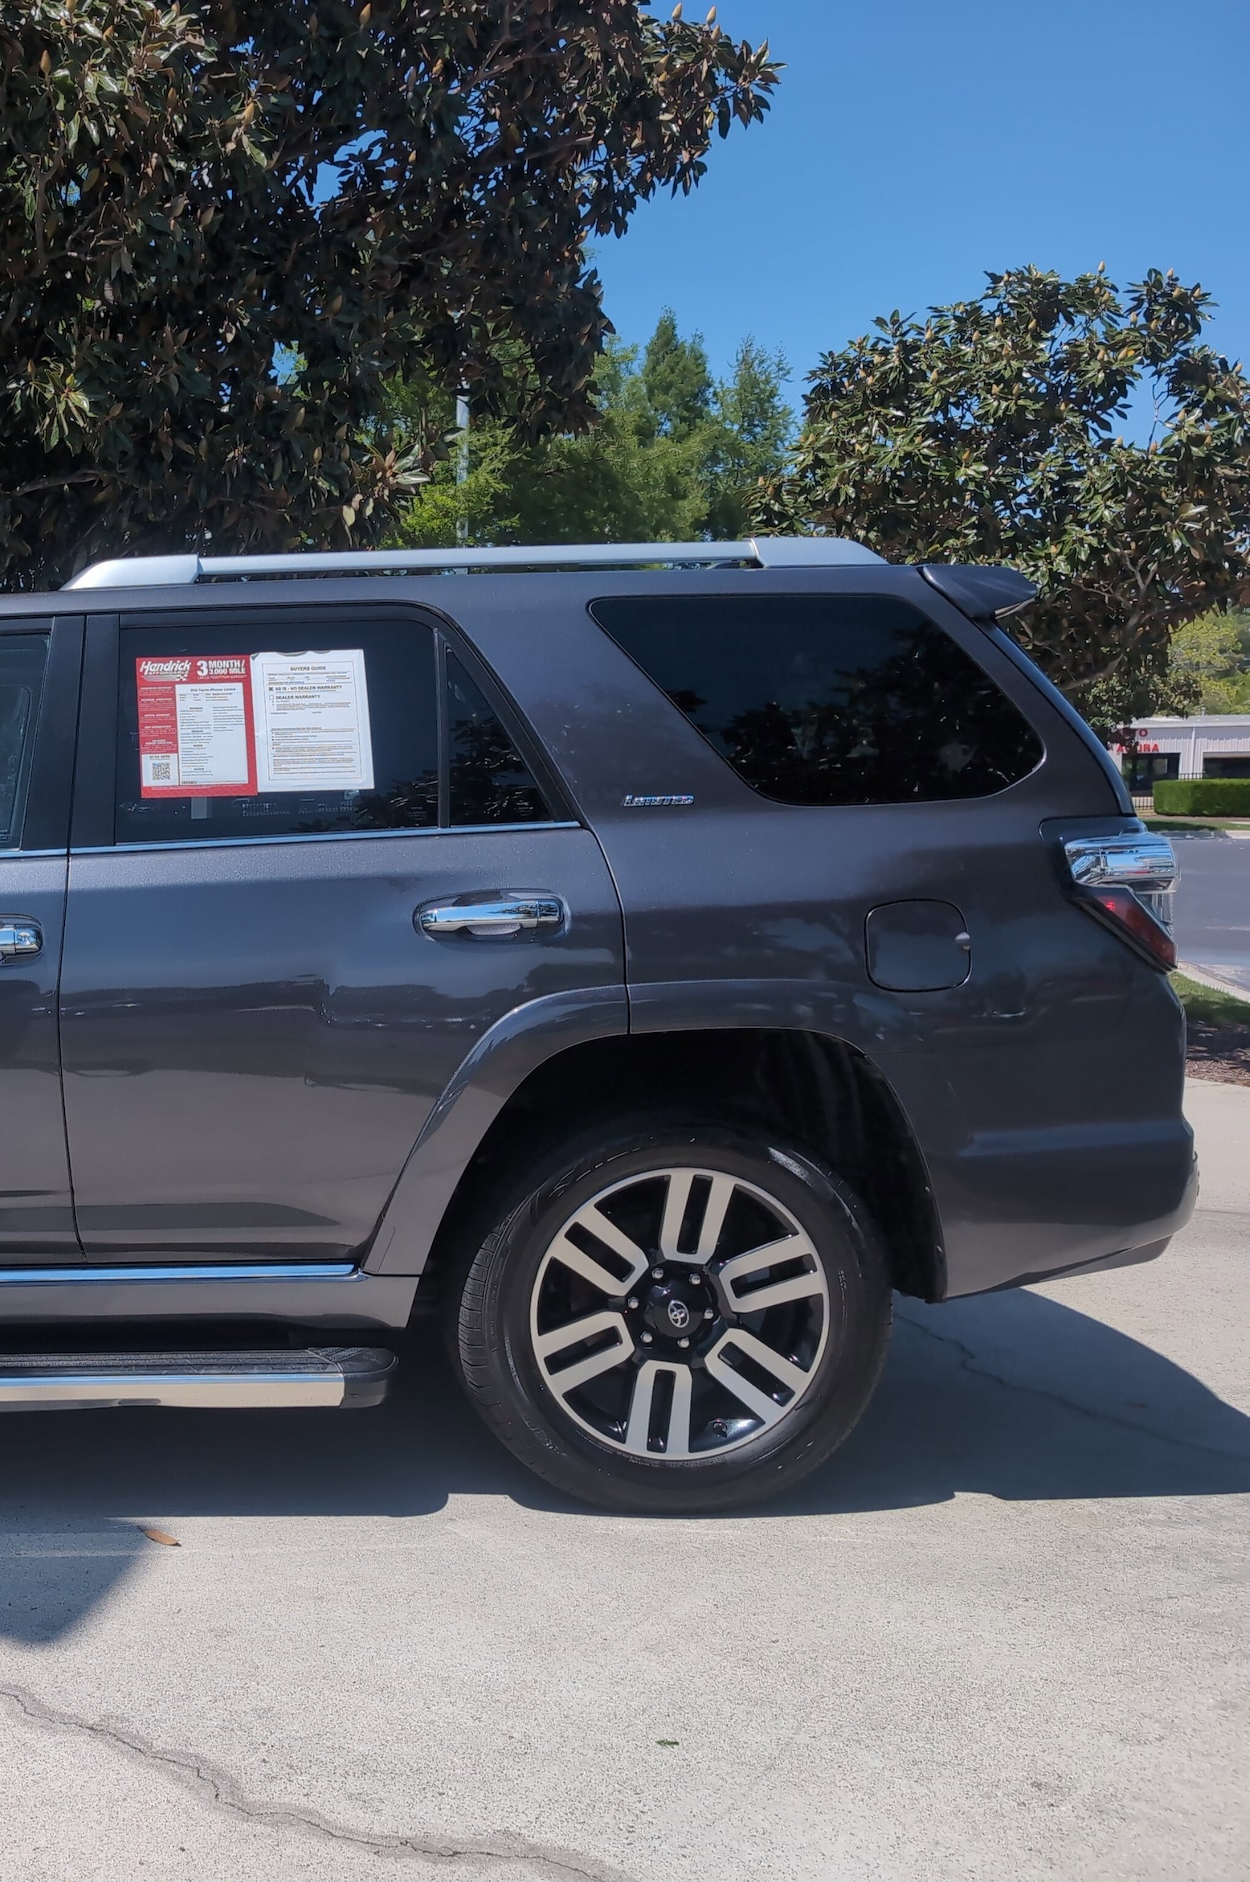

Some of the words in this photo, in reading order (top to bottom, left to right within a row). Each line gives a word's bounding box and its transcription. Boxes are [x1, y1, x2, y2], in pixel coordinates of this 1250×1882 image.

[140, 660, 191, 675] Hendrick
[197, 660, 208, 676] 3
[208, 660, 245, 668] MONTH/
[1117, 744, 1159, 752] ARA
